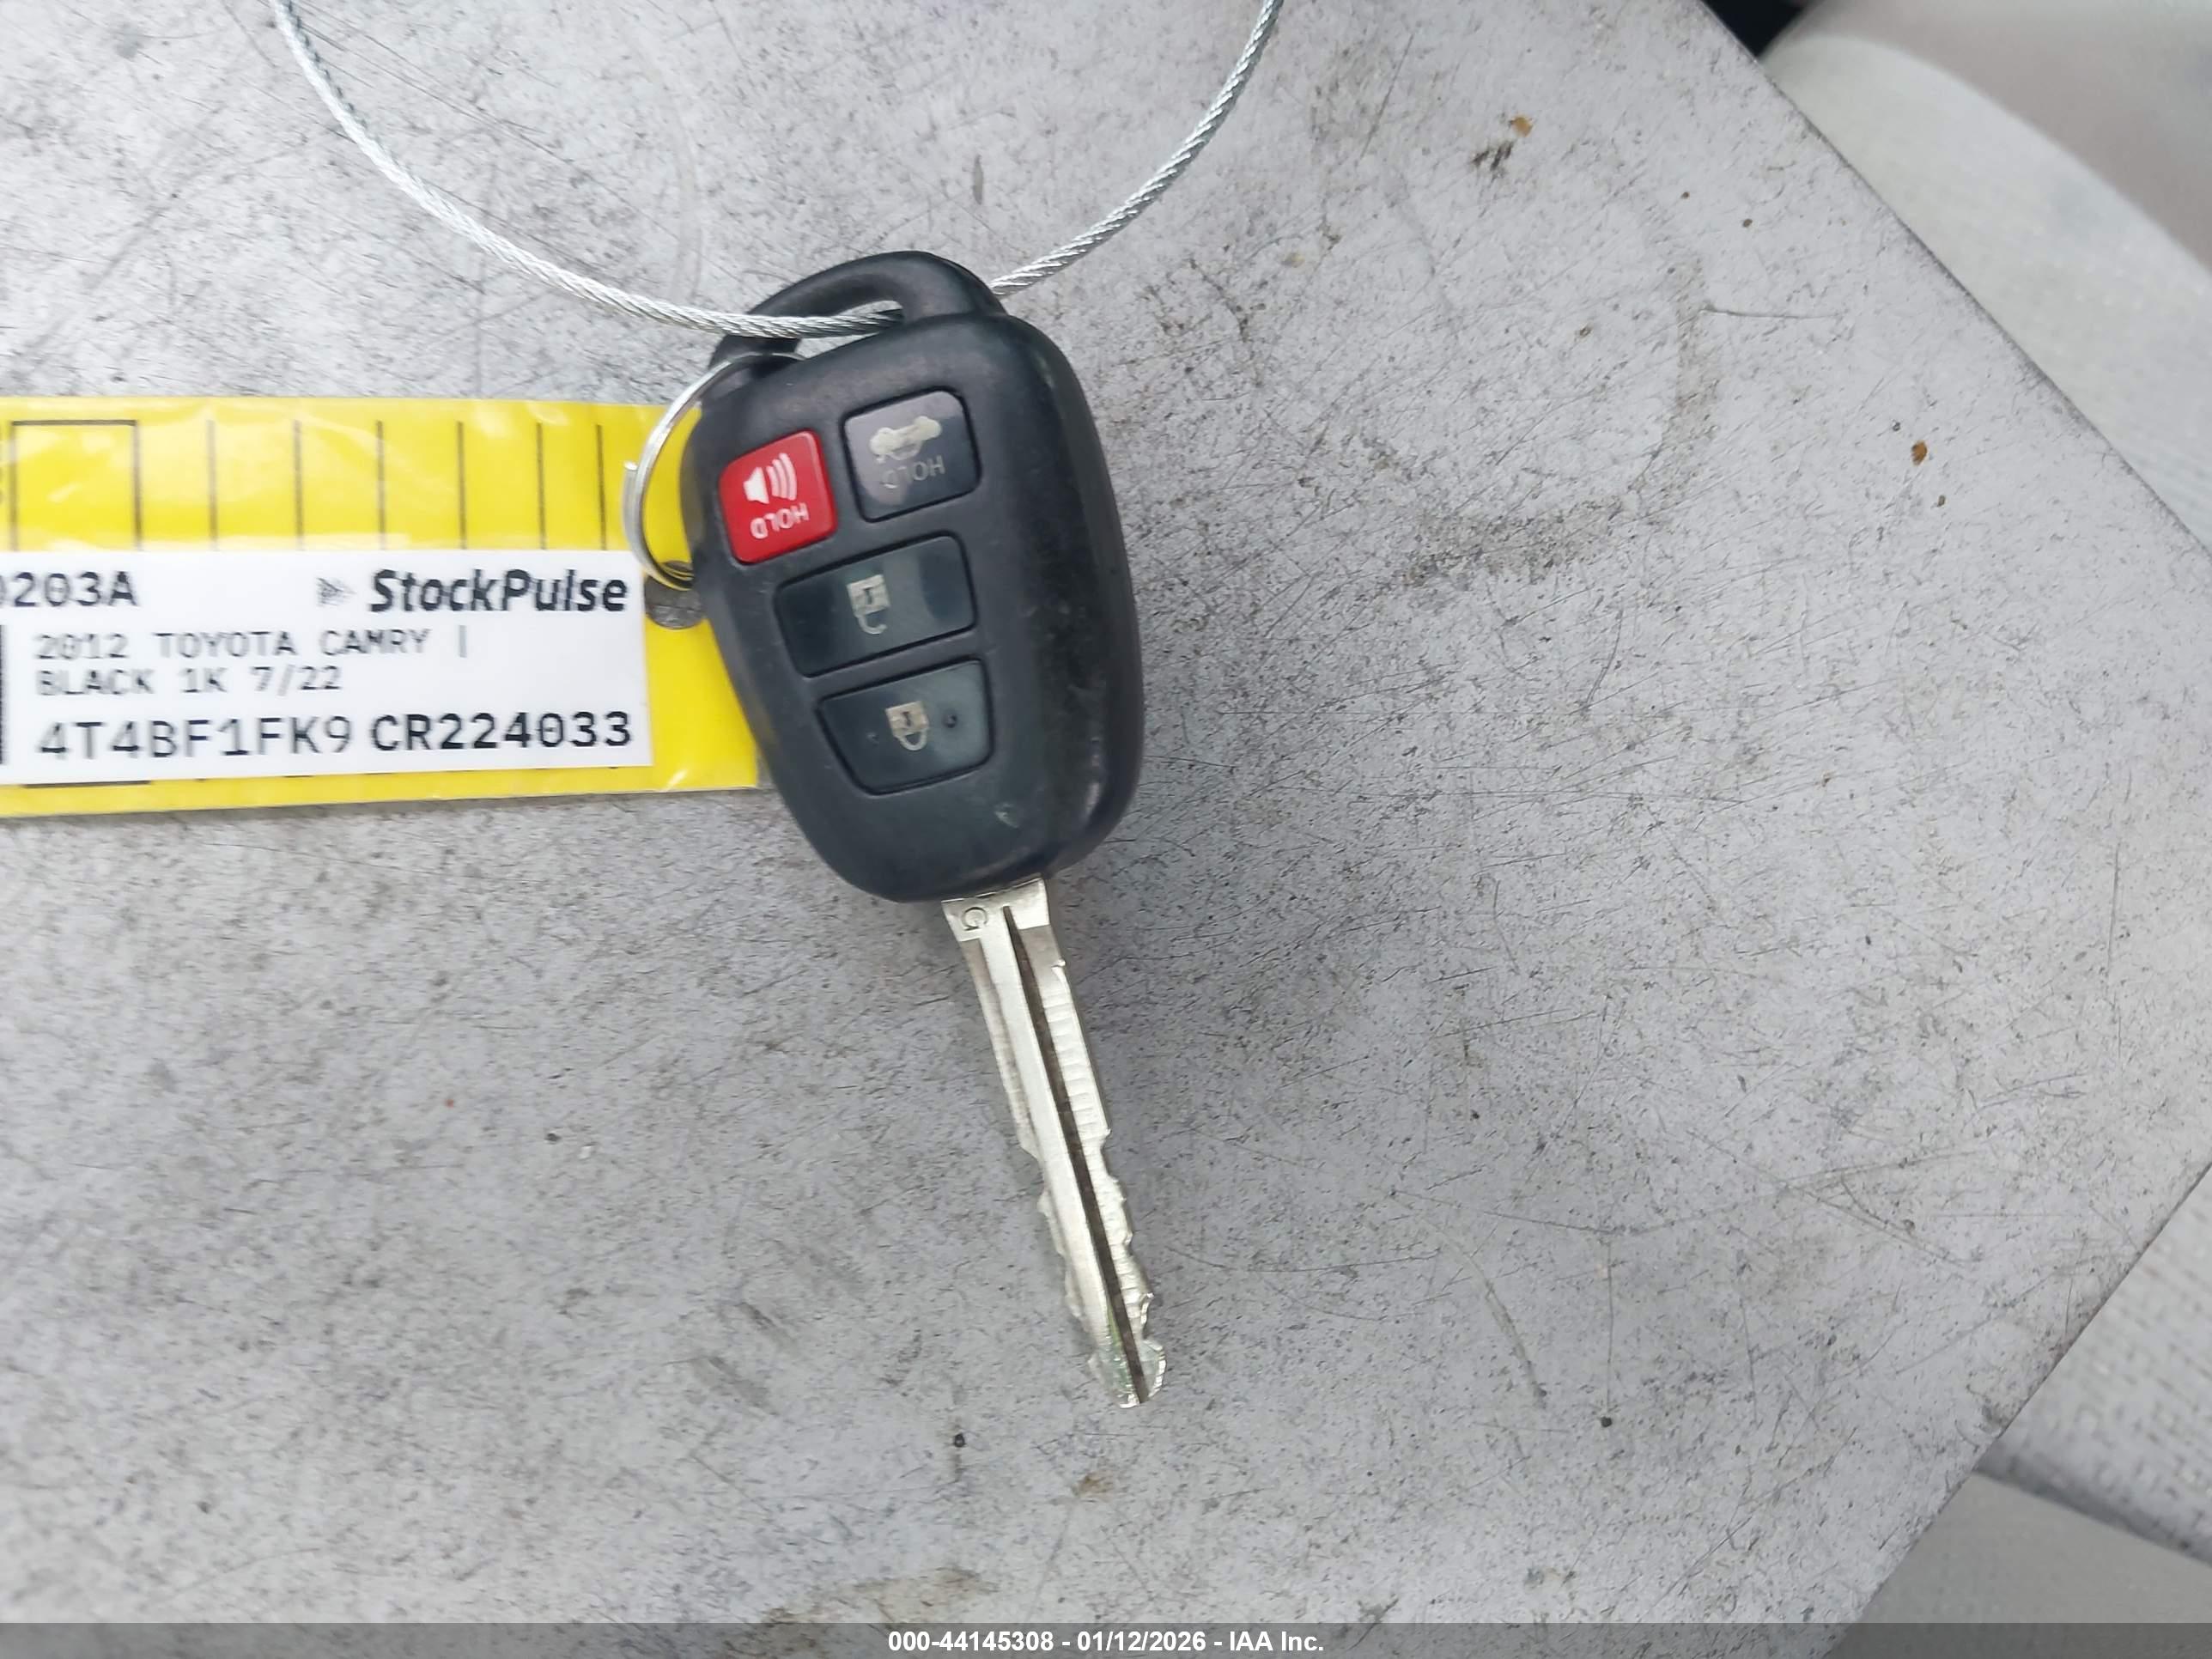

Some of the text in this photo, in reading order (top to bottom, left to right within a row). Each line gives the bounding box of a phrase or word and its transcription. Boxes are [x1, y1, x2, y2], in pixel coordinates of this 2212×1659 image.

[750, 502, 811, 539] HOLD
[0, 571, 139, 607] 203A
[369, 568, 628, 612] StockPulse
[34, 634, 130, 659] 2012
[153, 631, 298, 659] TOYOTA
[319, 629, 430, 656] CAMRY
[36, 665, 343, 696] BLACK 1K 7/22
[38, 711, 632, 759] 4T4BF1FK9 CR224033
